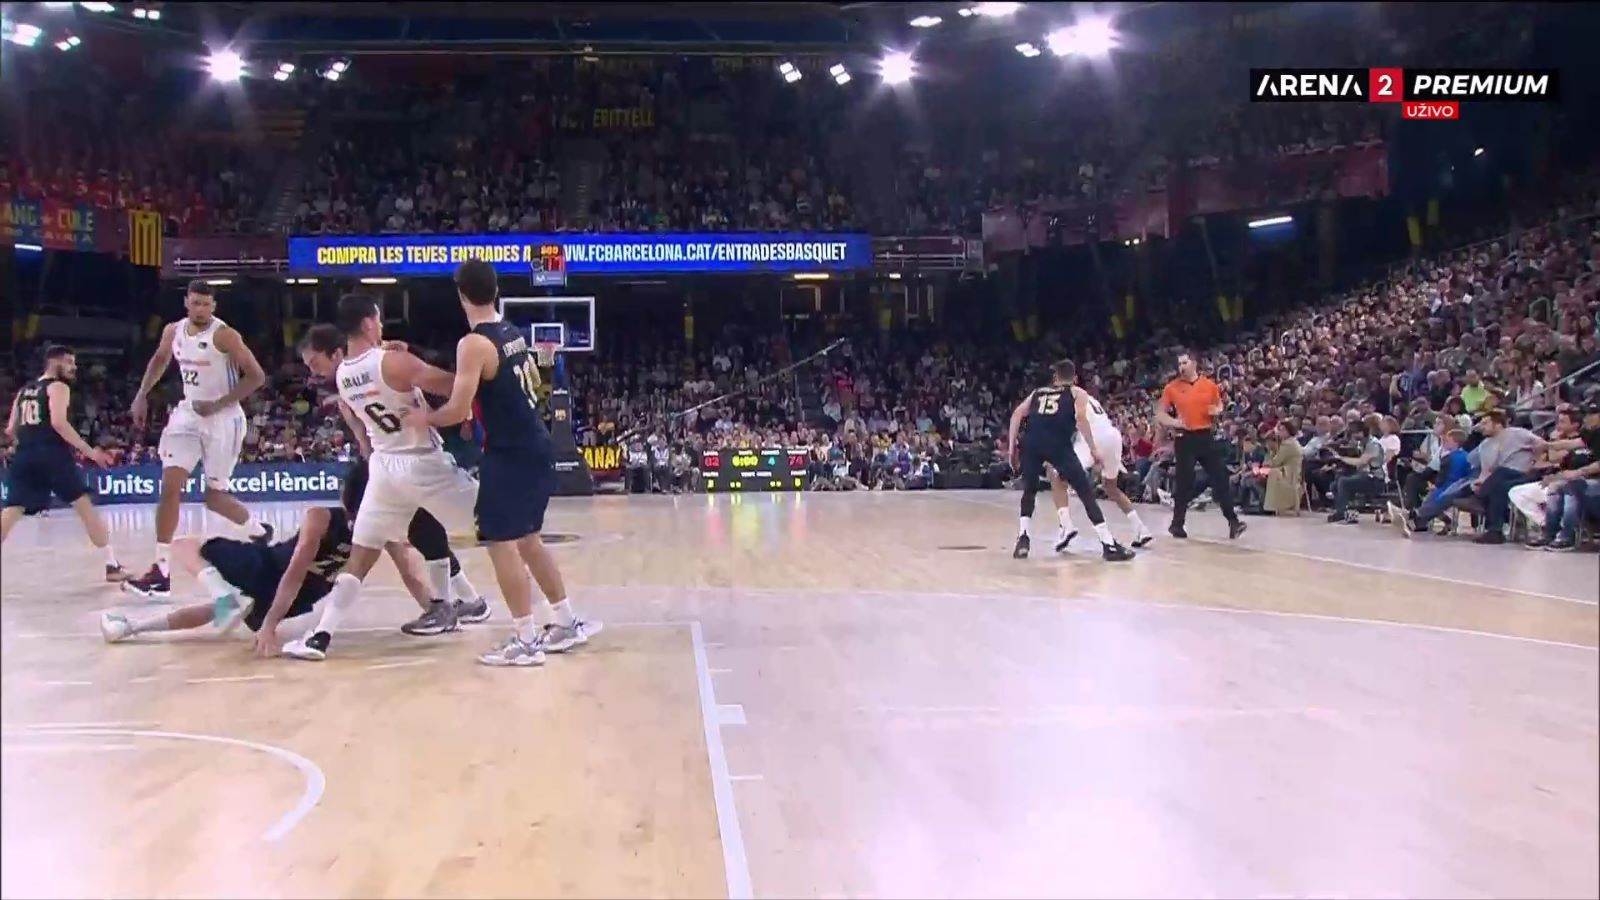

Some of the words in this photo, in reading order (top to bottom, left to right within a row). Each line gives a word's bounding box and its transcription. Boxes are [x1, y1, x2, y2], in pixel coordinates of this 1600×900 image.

[317, 246, 377, 265] COMPRA
[380, 246, 403, 264] LES
[406, 245, 448, 263] TEVES
[450, 244, 520, 263] ENTRADES
[183, 369, 199, 386] 22
[365, 402, 402, 433] 6
[98, 474, 155, 495] Units
